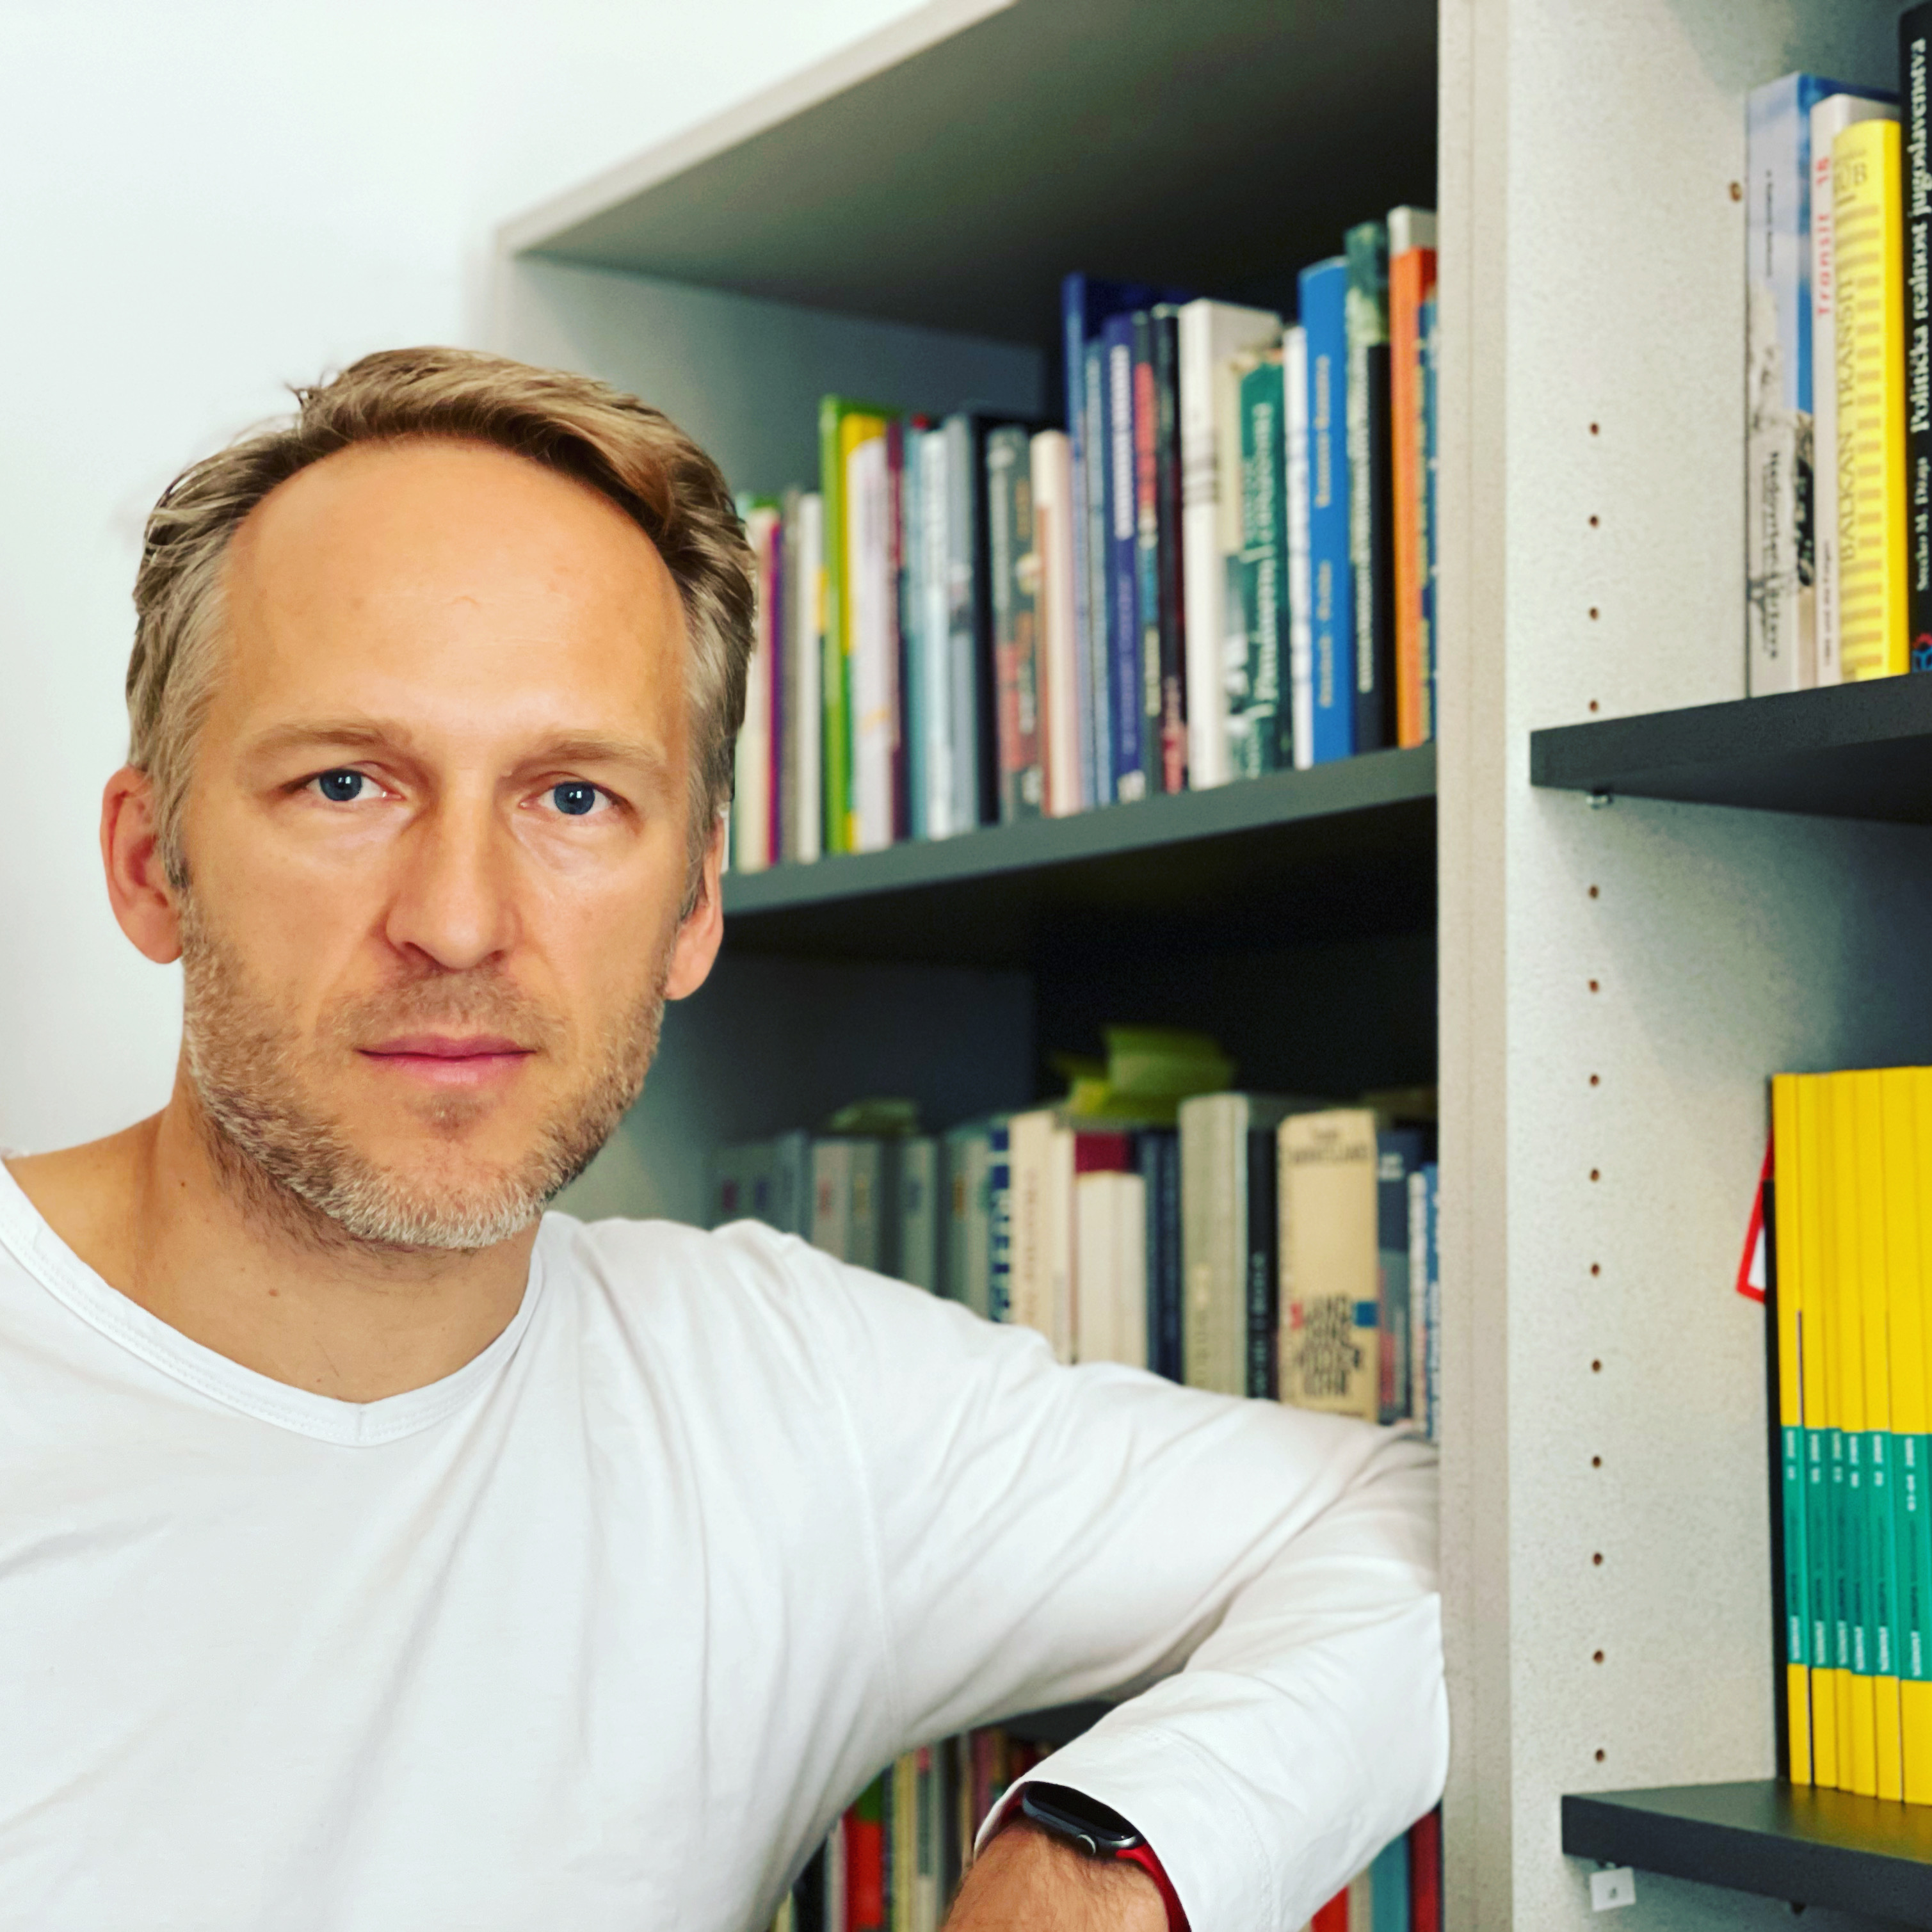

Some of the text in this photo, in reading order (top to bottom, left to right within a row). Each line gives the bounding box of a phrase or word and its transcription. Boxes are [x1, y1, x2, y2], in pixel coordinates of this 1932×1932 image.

[1816, 213, 1831, 316] Transit
[1907, 37, 1932, 431] Politička realnost jugoslavenstva
[1836, 278, 1855, 563] BALKAN TRANSIT
